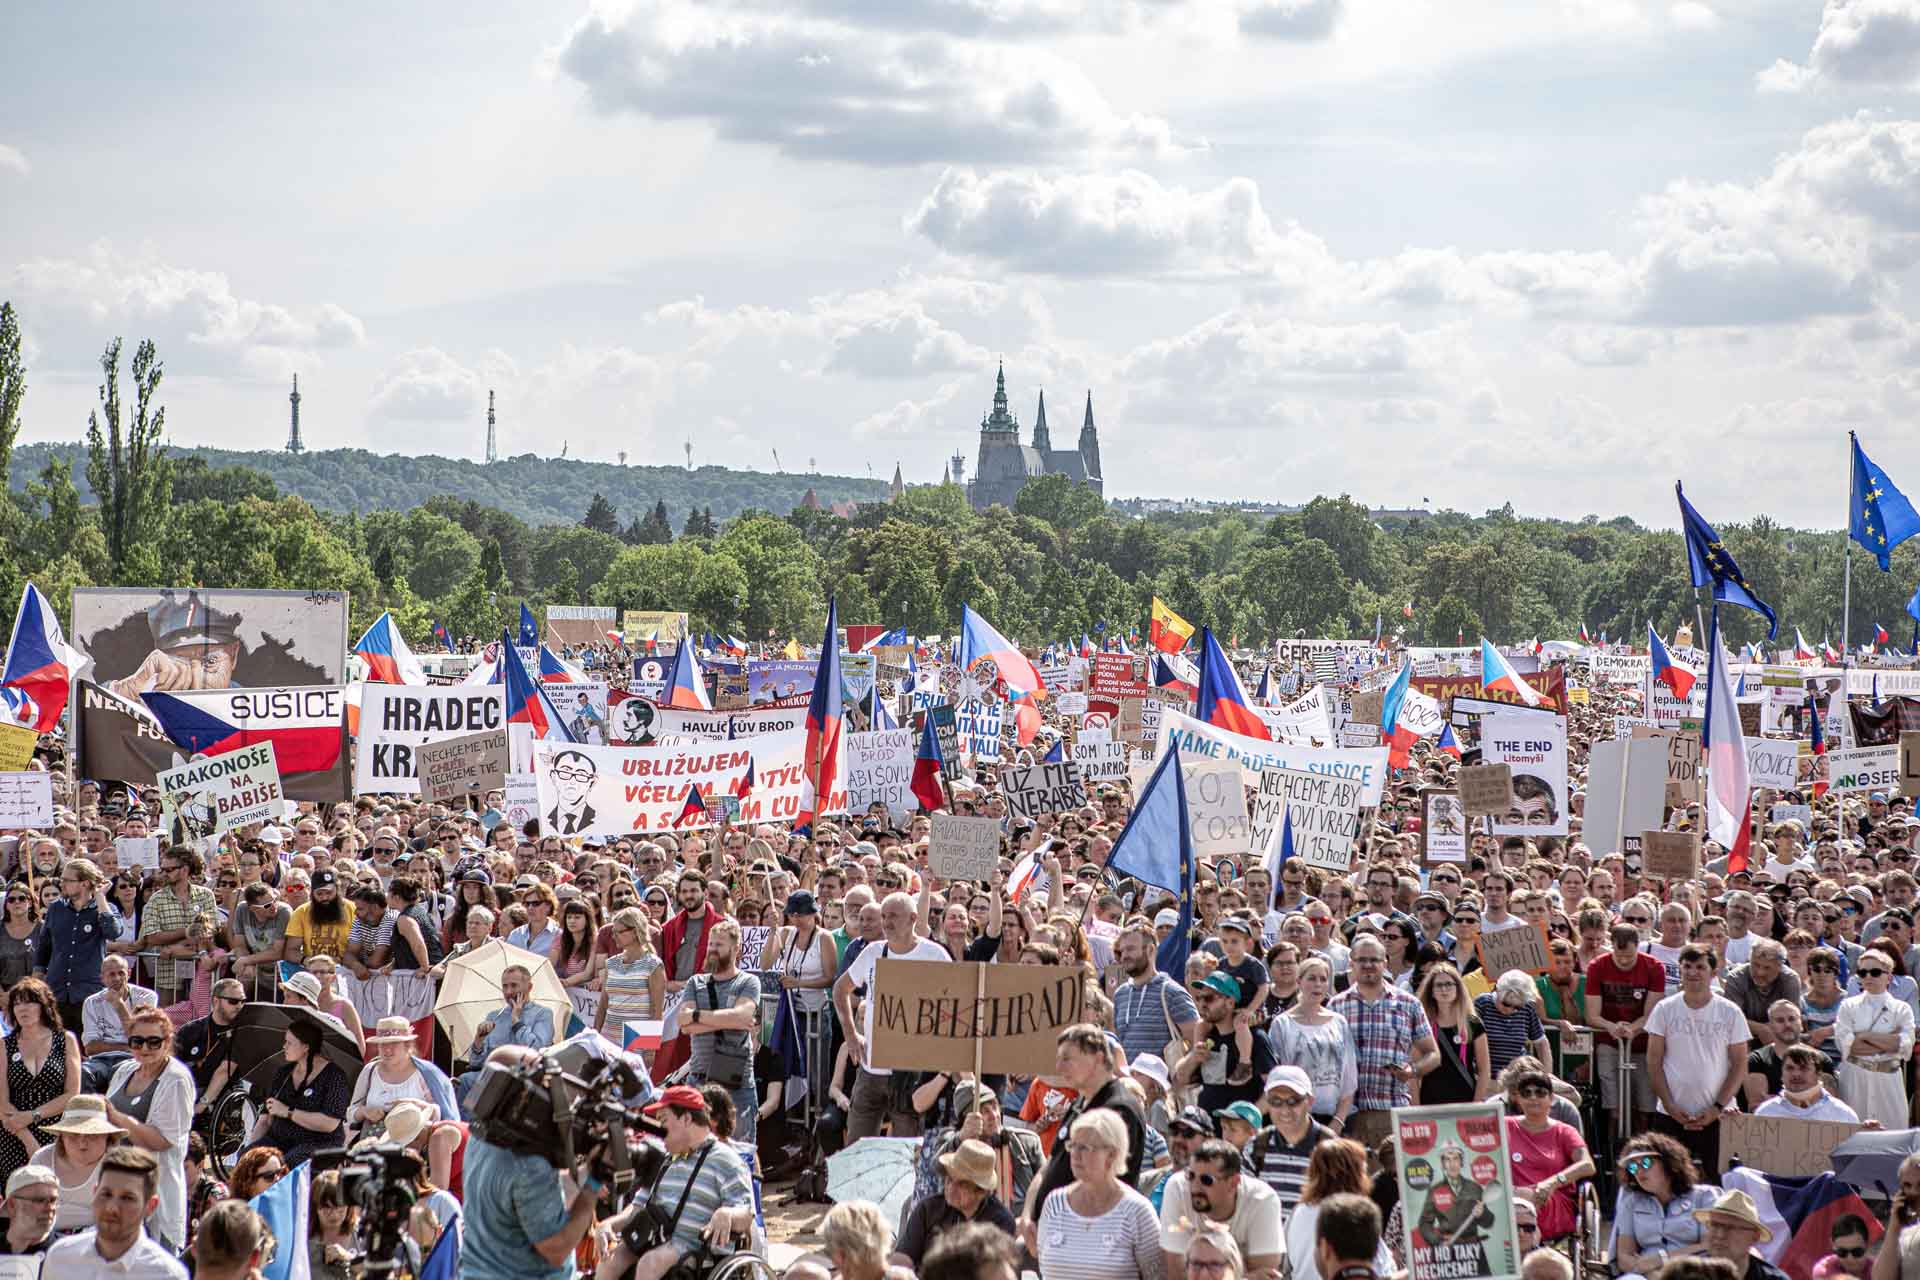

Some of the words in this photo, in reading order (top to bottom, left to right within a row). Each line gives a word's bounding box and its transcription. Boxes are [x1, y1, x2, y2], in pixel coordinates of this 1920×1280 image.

[230, 689, 340, 719] SUŠICE
[383, 697, 500, 731] HRADEC
[682, 720, 756, 733] HAVLÍČKŮV
[760, 721, 794, 732] BROD
[422, 742, 481, 765] NECHCEME
[483, 735, 506, 751] TVŮJ
[847, 731, 908, 751] AVLÍČKŮV
[1075, 745, 1097, 759] SOM
[1106, 743, 1121, 757] TU
[1168, 728, 1223, 758] MÁME
[1494, 741, 1520, 751] THE
[1524, 741, 1552, 751] END
[622, 751, 750, 776] UBLIŽUJEM
[861, 750, 896, 761] BROD
[1503, 753, 1544, 763] Litomyšl
[163, 747, 270, 792] KRAKONOŠE
[427, 766, 479, 787] NECHCEME
[848, 765, 910, 786] ABIŠOVU
[1668, 758, 1698, 781] VIDÍ
[230, 773, 254, 790] NA
[432, 783, 456, 798] HRY
[218, 780, 280, 814] BABIŠE
[849, 787, 904, 807] DEMISI
[1332, 783, 1361, 809] ABY
[633, 813, 648, 830] A
[1256, 798, 1319, 831] MAOVÍ
[1320, 810, 1356, 838] VRAZI
[879, 993, 908, 1034] NA
[1413, 1247, 1434, 1263] MY
[1434, 1245, 1451, 1262] HO
[1453, 1243, 1481, 1261] TAKY
[1415, 1261, 1479, 1280] NECHCEME!
